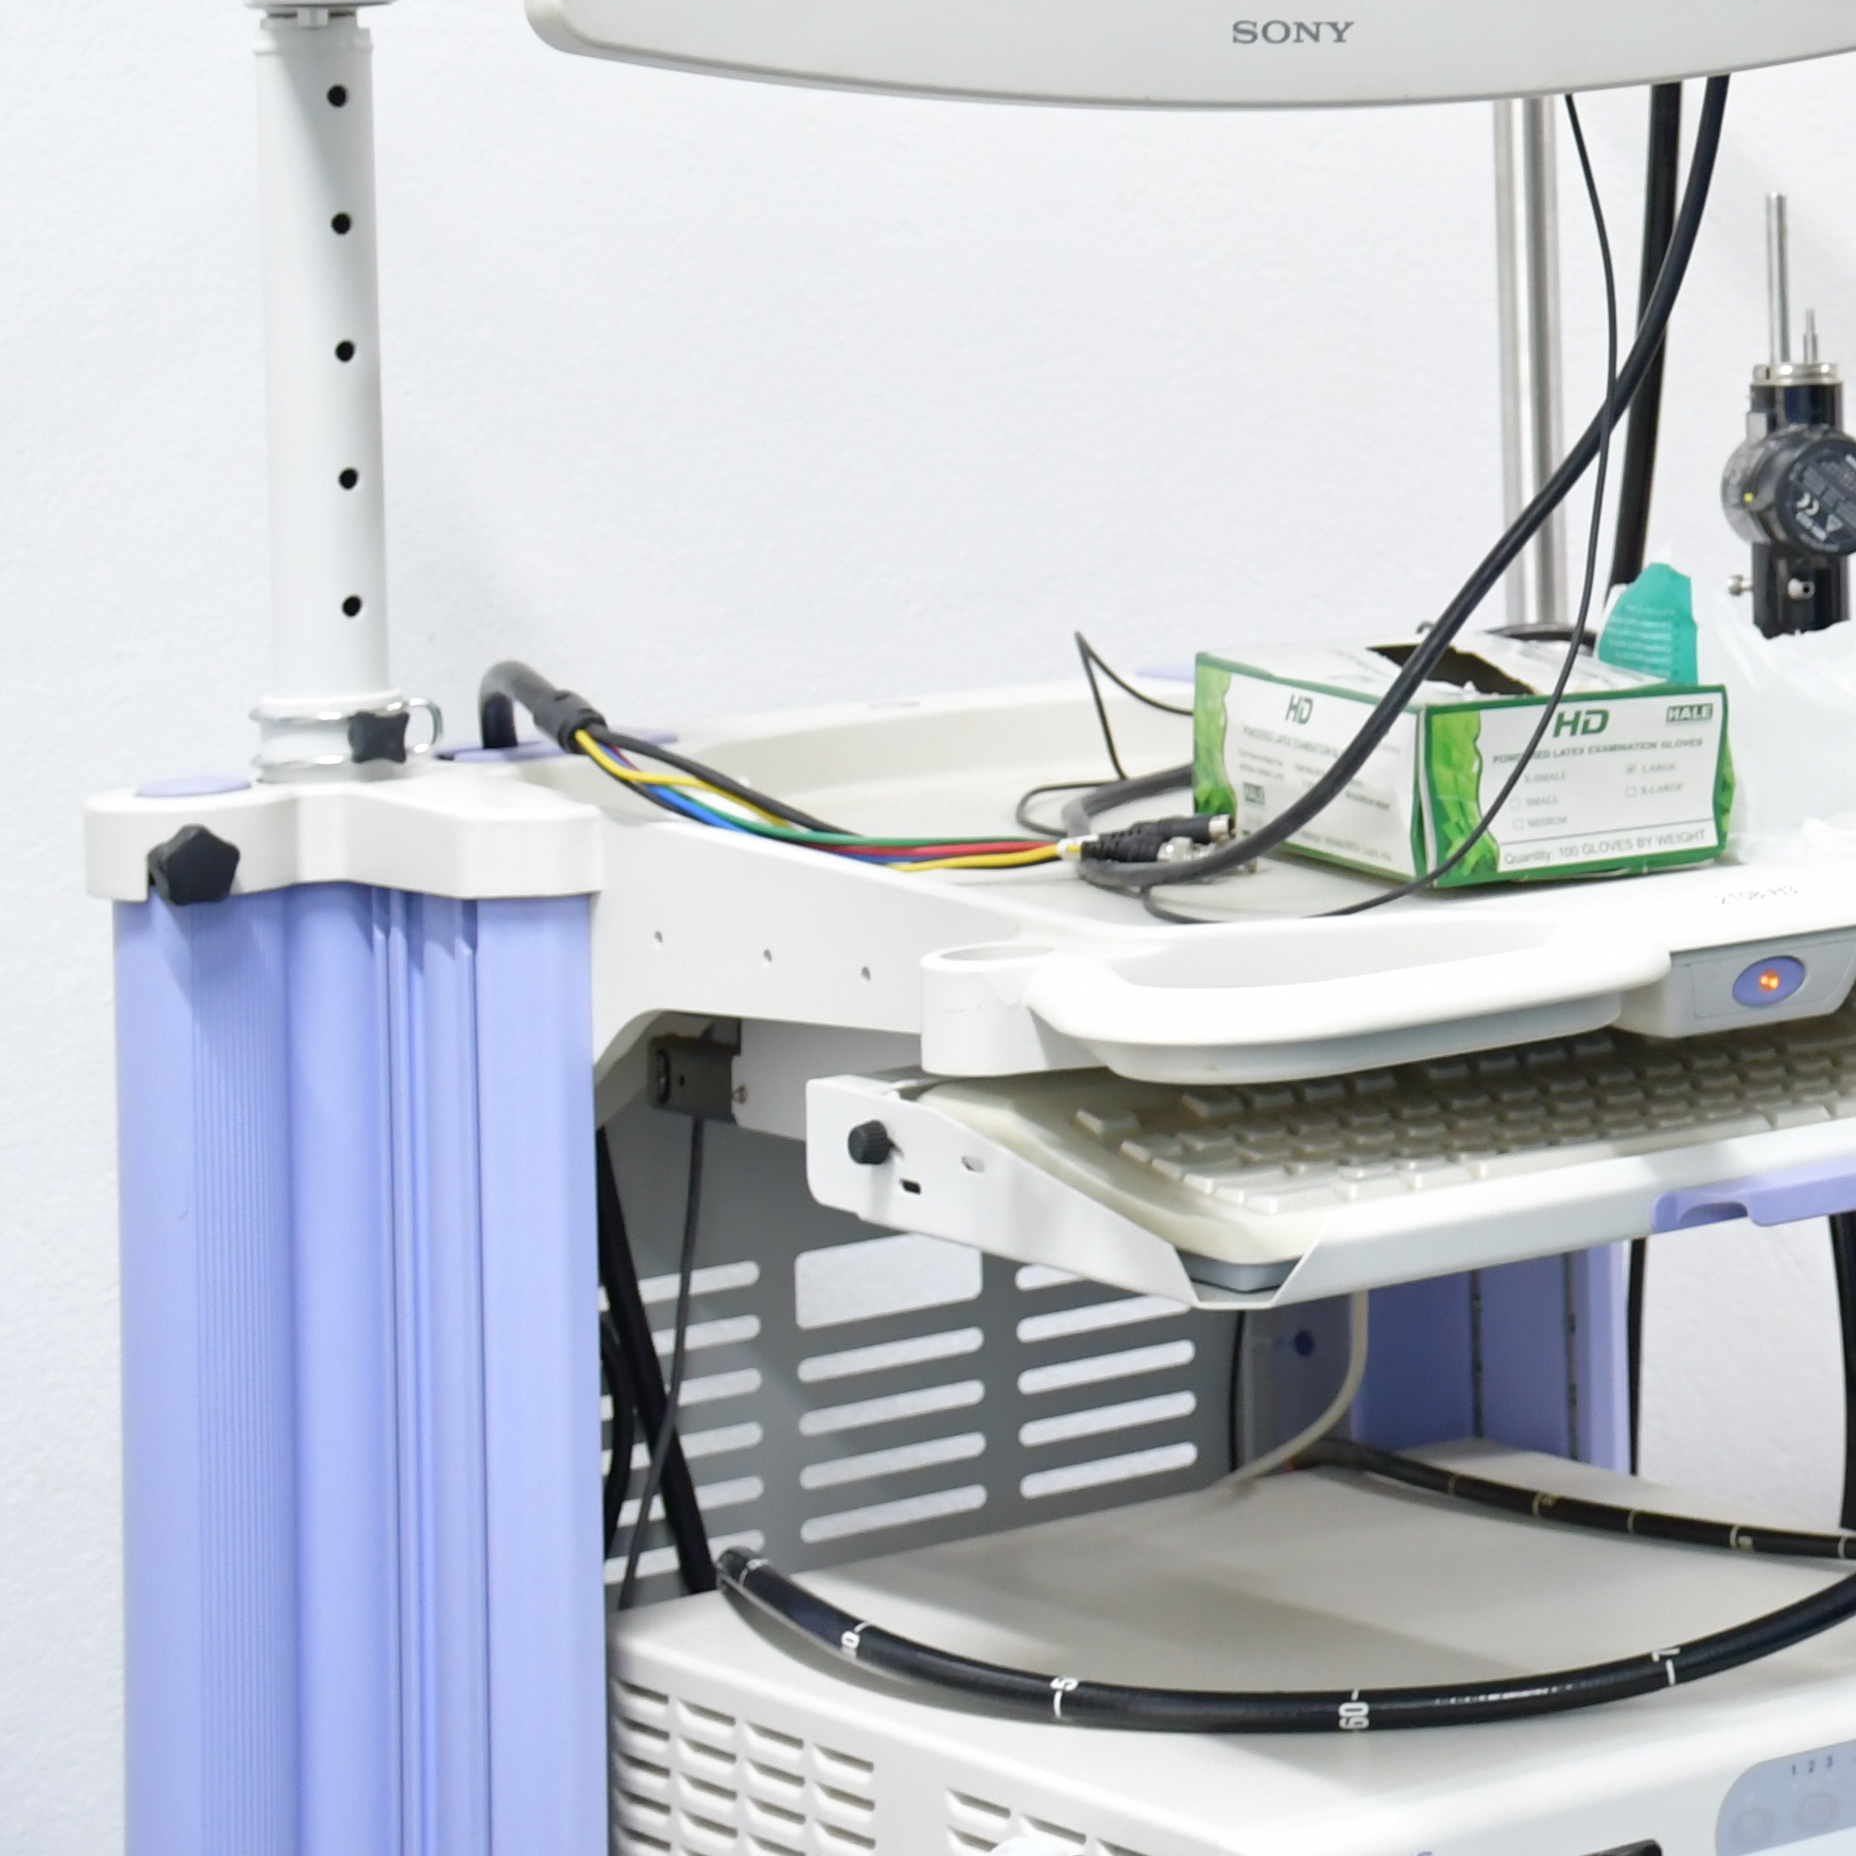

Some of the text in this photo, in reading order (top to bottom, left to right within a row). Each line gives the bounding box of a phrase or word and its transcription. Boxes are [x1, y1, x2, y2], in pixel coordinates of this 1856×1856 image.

[1232, 20, 1355, 45] SONY
[1286, 694, 1314, 725] HD
[1667, 704, 1712, 722] HALE
[1552, 708, 1610, 739] HD
[1553, 746, 1586, 759] LATEX
[1587, 740, 1658, 756] EXAMINATION
[1660, 737, 1704, 749] GLOVES
[1558, 846, 1580, 859] 100
[1582, 841, 1635, 857] GLOVES
[1636, 835, 1655, 850] BY
[1657, 829, 1706, 845] WEIGHT
